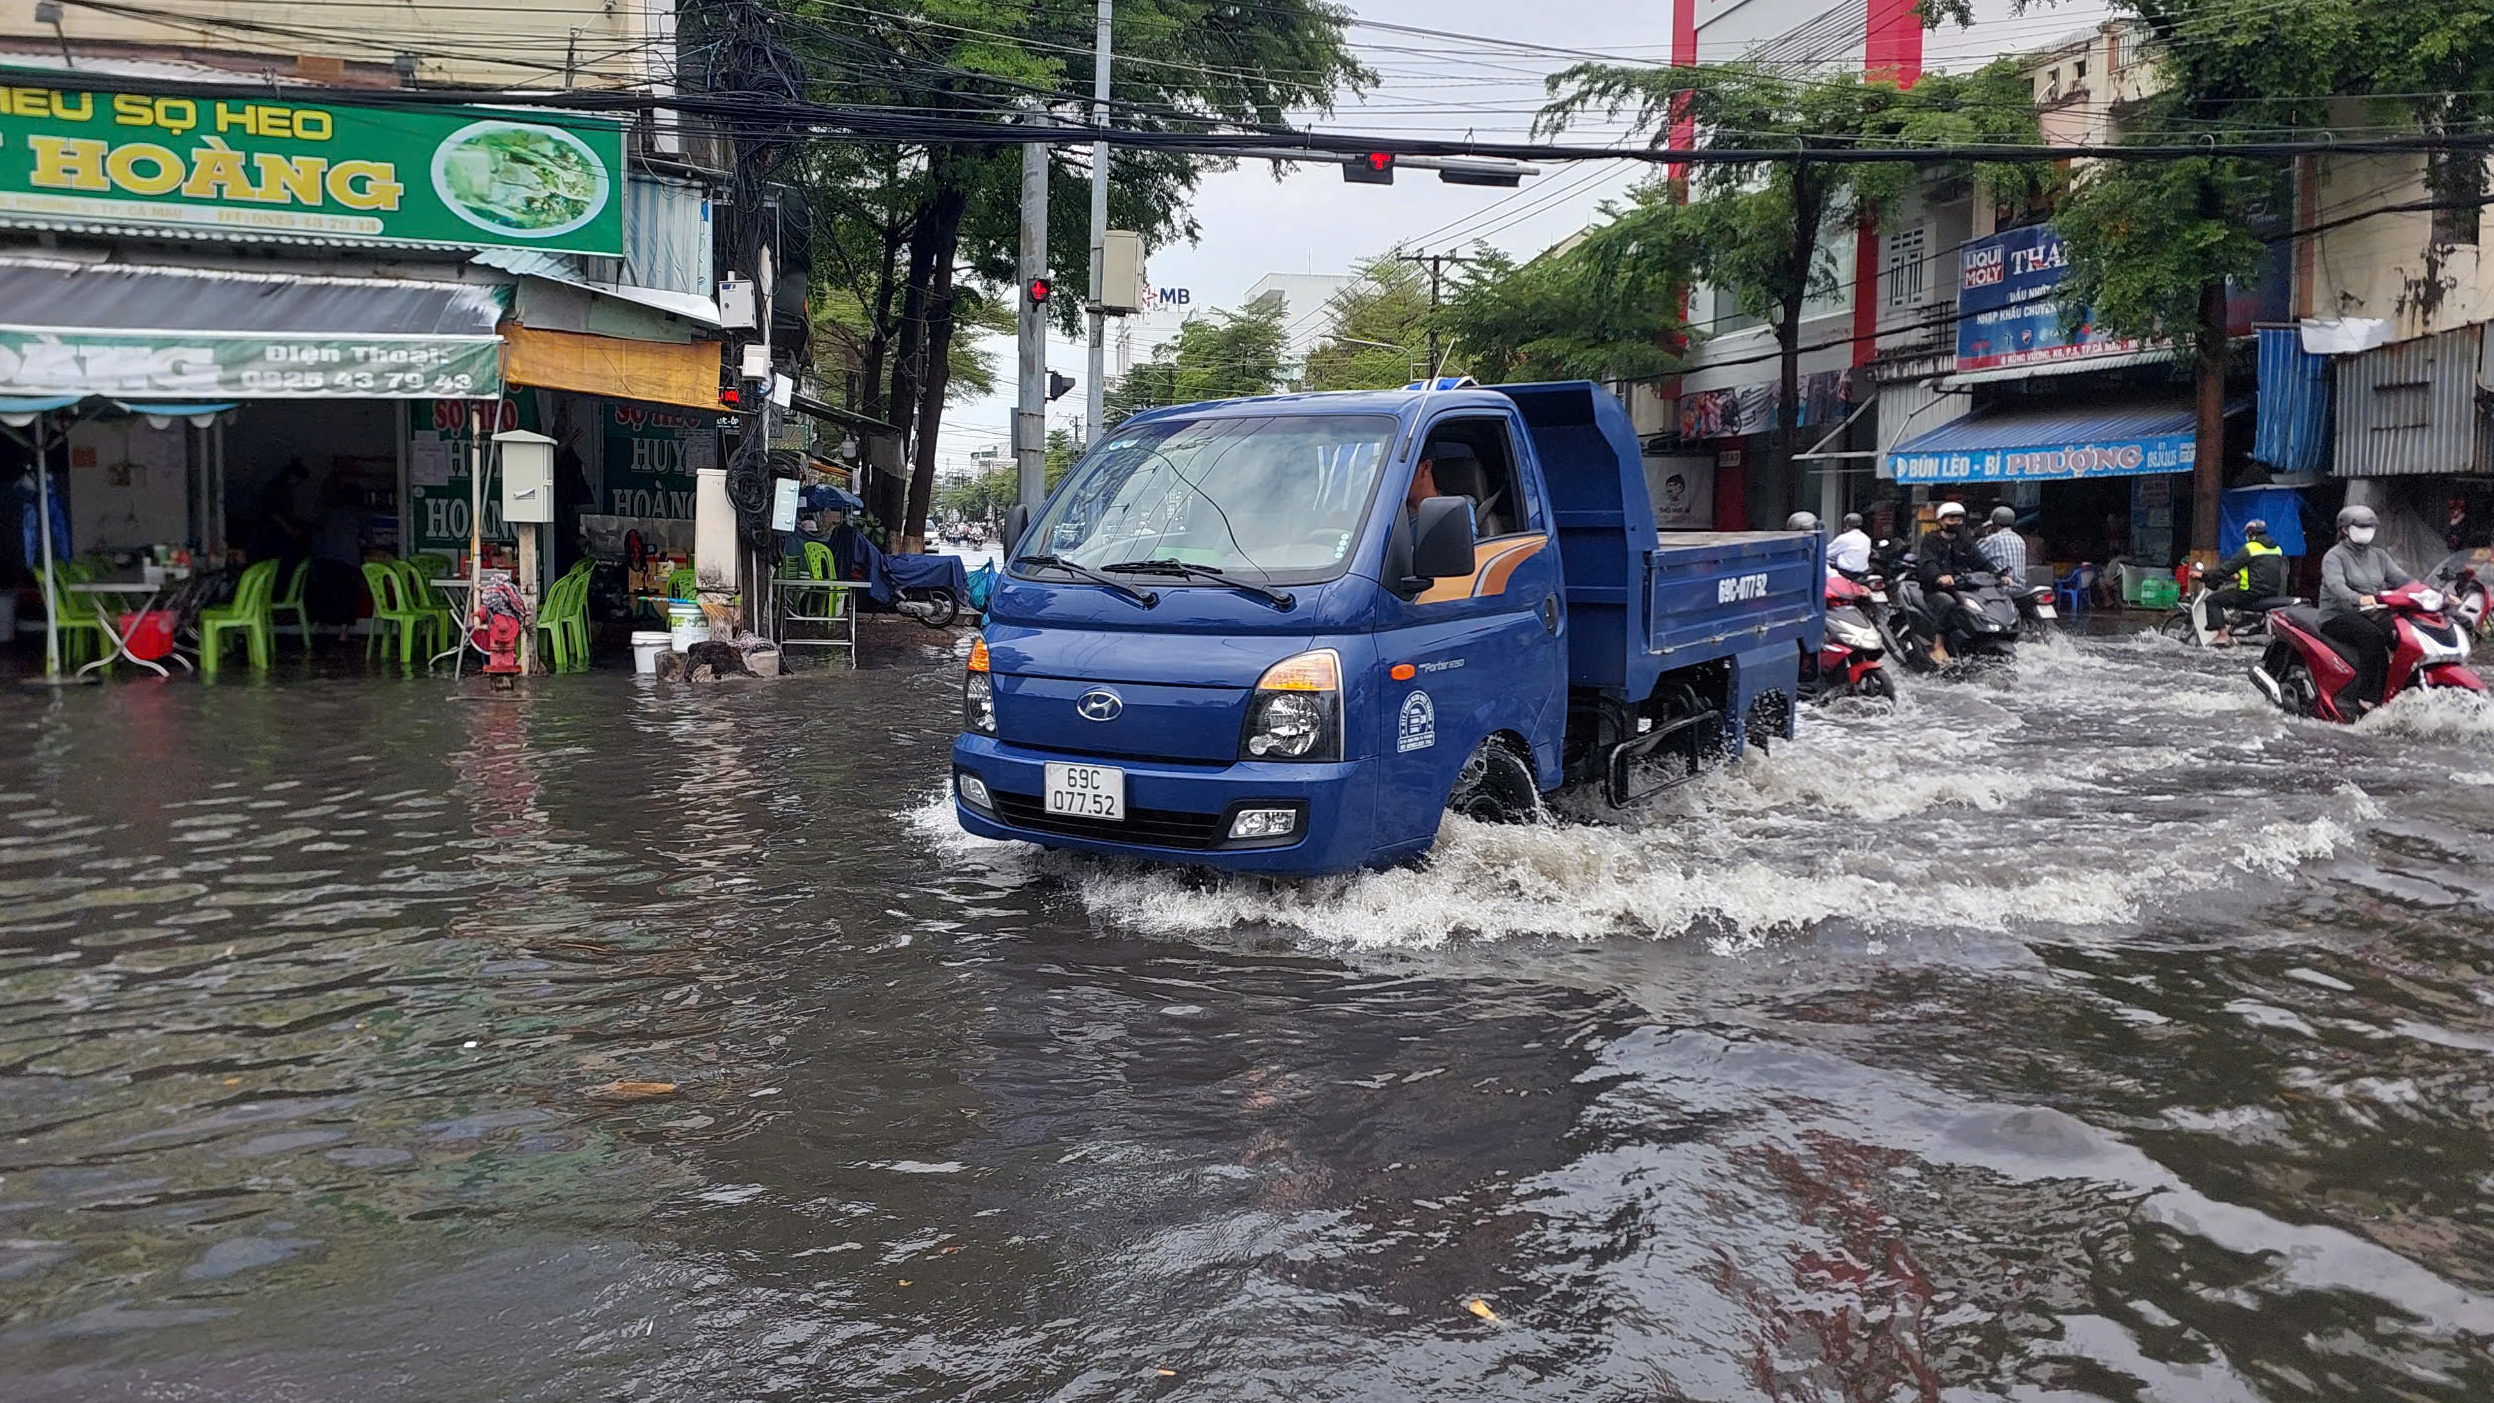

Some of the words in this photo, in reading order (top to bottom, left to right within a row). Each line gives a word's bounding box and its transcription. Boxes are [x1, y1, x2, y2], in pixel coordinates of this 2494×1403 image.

[114, 93, 197, 136] SỌ
[216, 102, 333, 141] HEO
[28, 134, 404, 211] HOÀNG
[1966, 248, 2001, 268] LIQUI
[1965, 265, 2001, 287] MOLY
[1160, 288, 1190, 304] MB
[240, 371, 325, 388] 0825
[333, 371, 376, 388] 43
[385, 372, 425, 390] 79
[435, 374, 474, 390] 43
[631, 437, 687, 473] HUY
[2004, 443, 2143, 478] PHƯỢNG
[1067, 767, 1101, 790] 69C
[1054, 790, 1115, 816] 077.52
